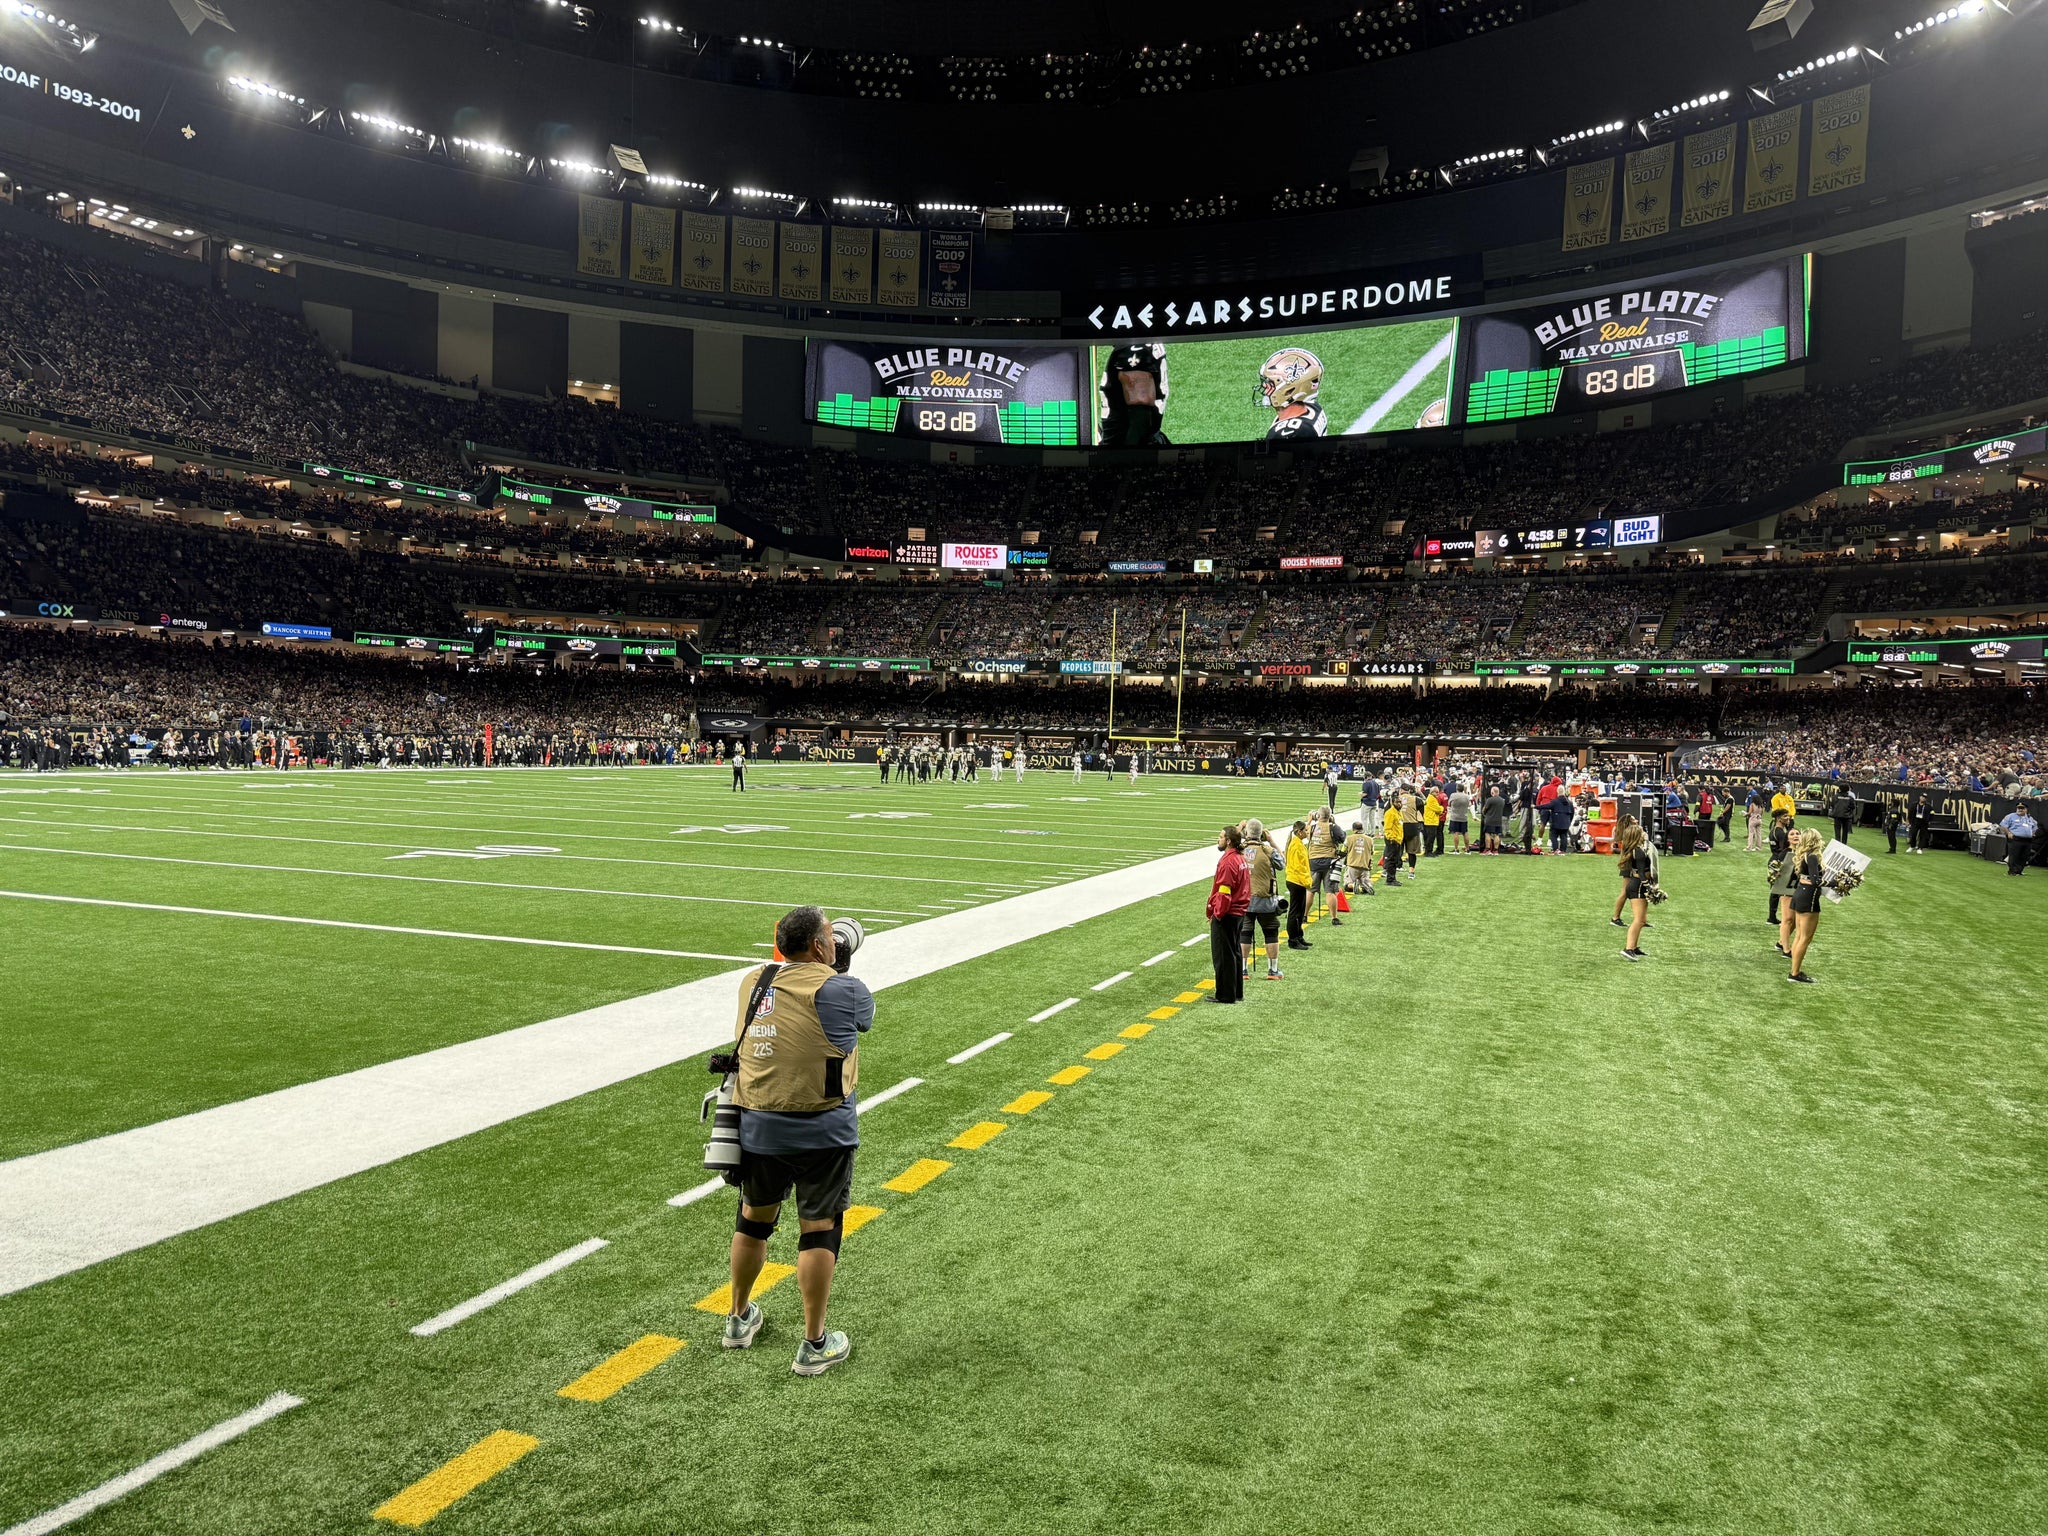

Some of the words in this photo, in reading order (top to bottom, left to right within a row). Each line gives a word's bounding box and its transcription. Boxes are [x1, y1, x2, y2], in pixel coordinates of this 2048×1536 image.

[53, 82, 141, 122] 1993-2001
[1819, 111, 1860, 134] 2020
[1756, 131, 1791, 152] 2019
[1691, 148, 1727, 168] 2018
[1632, 166, 1665, 185] 2017
[1574, 180, 1604, 197] 2011
[1813, 172, 1861, 193] SAINTS
[1748, 190, 1793, 210] SAINTS
[1685, 206, 1729, 224] SAINTS
[689, 230, 716, 244] 1991
[1624, 222, 1666, 240] SAINTS
[737, 235, 769, 248] 2000
[1566, 233, 1606, 248] SAINTS
[786, 241, 816, 254] 2006
[837, 244, 867, 256] 2009
[884, 248, 915, 259] 2009
[936, 250, 965, 260] 2009
[684, 278, 720, 290] SAINTS
[734, 282, 770, 294] SAINTS
[782, 288, 818, 299] SAINTS
[833, 291, 868, 302] SAINTS
[880, 294, 916, 305] SAINTS
[931, 296, 966, 306] SAINTS
[1088, 296, 1254, 330] CAESARS
[1259, 276, 1452, 318] SUPERDOME
[1534, 298, 1612, 345] BLUE
[1621, 290, 1719, 318] PLATE
[1600, 316, 1650, 342] Real
[1559, 330, 1689, 360] MAYONNAISE
[874, 348, 940, 379] BLUE
[948, 348, 1026, 382] PLATE
[930, 370, 972, 386] Real
[1586, 369, 1618, 396] 83
[1622, 364, 1655, 391] dB
[896, 386, 1003, 399] MAYONNAISE
[920, 410, 946, 431] 83
[950, 411, 976, 432] dB
[90, 420, 131, 437] SAINTS
[174, 438, 212, 454] SAINTS
[1974, 442, 1992, 458] BLUE
[1994, 440, 2016, 450] PLATE
[252, 454, 287, 469] SAINTS
[36, 468, 76, 482] SAINTS
[1890, 472, 1900, 480] 83
[1902, 470, 1912, 480] dB
[120, 482, 156, 496] SAINTS
[274, 506, 304, 520] SAINTS
[2030, 508, 2048, 518] SAI
[1622, 520, 1650, 532] BUD
[1937, 516, 1979, 528] SAINTS
[1575, 528, 1586, 541] 7
[1846, 524, 1886, 534] SAINTS
[1498, 534, 1508, 548] 6
[1528, 530, 1554, 542] 4:58
[1617, 530, 1656, 543] LIGHT
[1442, 541, 1474, 550] TOYOTA
[848, 546, 888, 559] verizon
[954, 546, 998, 560] ROUSES
[1354, 554, 1384, 564] SAINTS
[1222, 558, 1250, 568] SAINTS
[1280, 558, 1308, 567] ROUSES
[1309, 556, 1342, 566] MARKETS
[38, 603, 74, 618] COX
[101, 608, 140, 621] SAINTS
[172, 616, 208, 630] entergy
[272, 626, 301, 636] HANCOCK
[303, 628, 332, 638] WHITNEY
[1970, 642, 1988, 652] BLUE
[1990, 642, 2011, 652] PLATE
[934, 658, 962, 667] SAINTS
[1883, 653, 1894, 662] 83
[1894, 653, 1904, 662] dB
[974, 661, 1026, 673] Ochsner
[1062, 662, 1092, 672] PEOPLES
[1137, 662, 1167, 670] SAINTS
[1205, 662, 1236, 670] SAINTS
[1260, 664, 1312, 676] verizon
[1334, 662, 1346, 674] 19
[1363, 663, 1424, 674] CAESARS
[1436, 662, 1470, 670] SAINTS
[808, 748, 855, 760] SAINTS
[1030, 756, 1073, 767] SAINT
[1152, 760, 1196, 772] AINTS
[1266, 762, 1320, 776] SAINTS
[758, 998, 770, 1014] FL
[749, 1024, 777, 1038] MEDIA
[753, 1042, 774, 1057] 225
